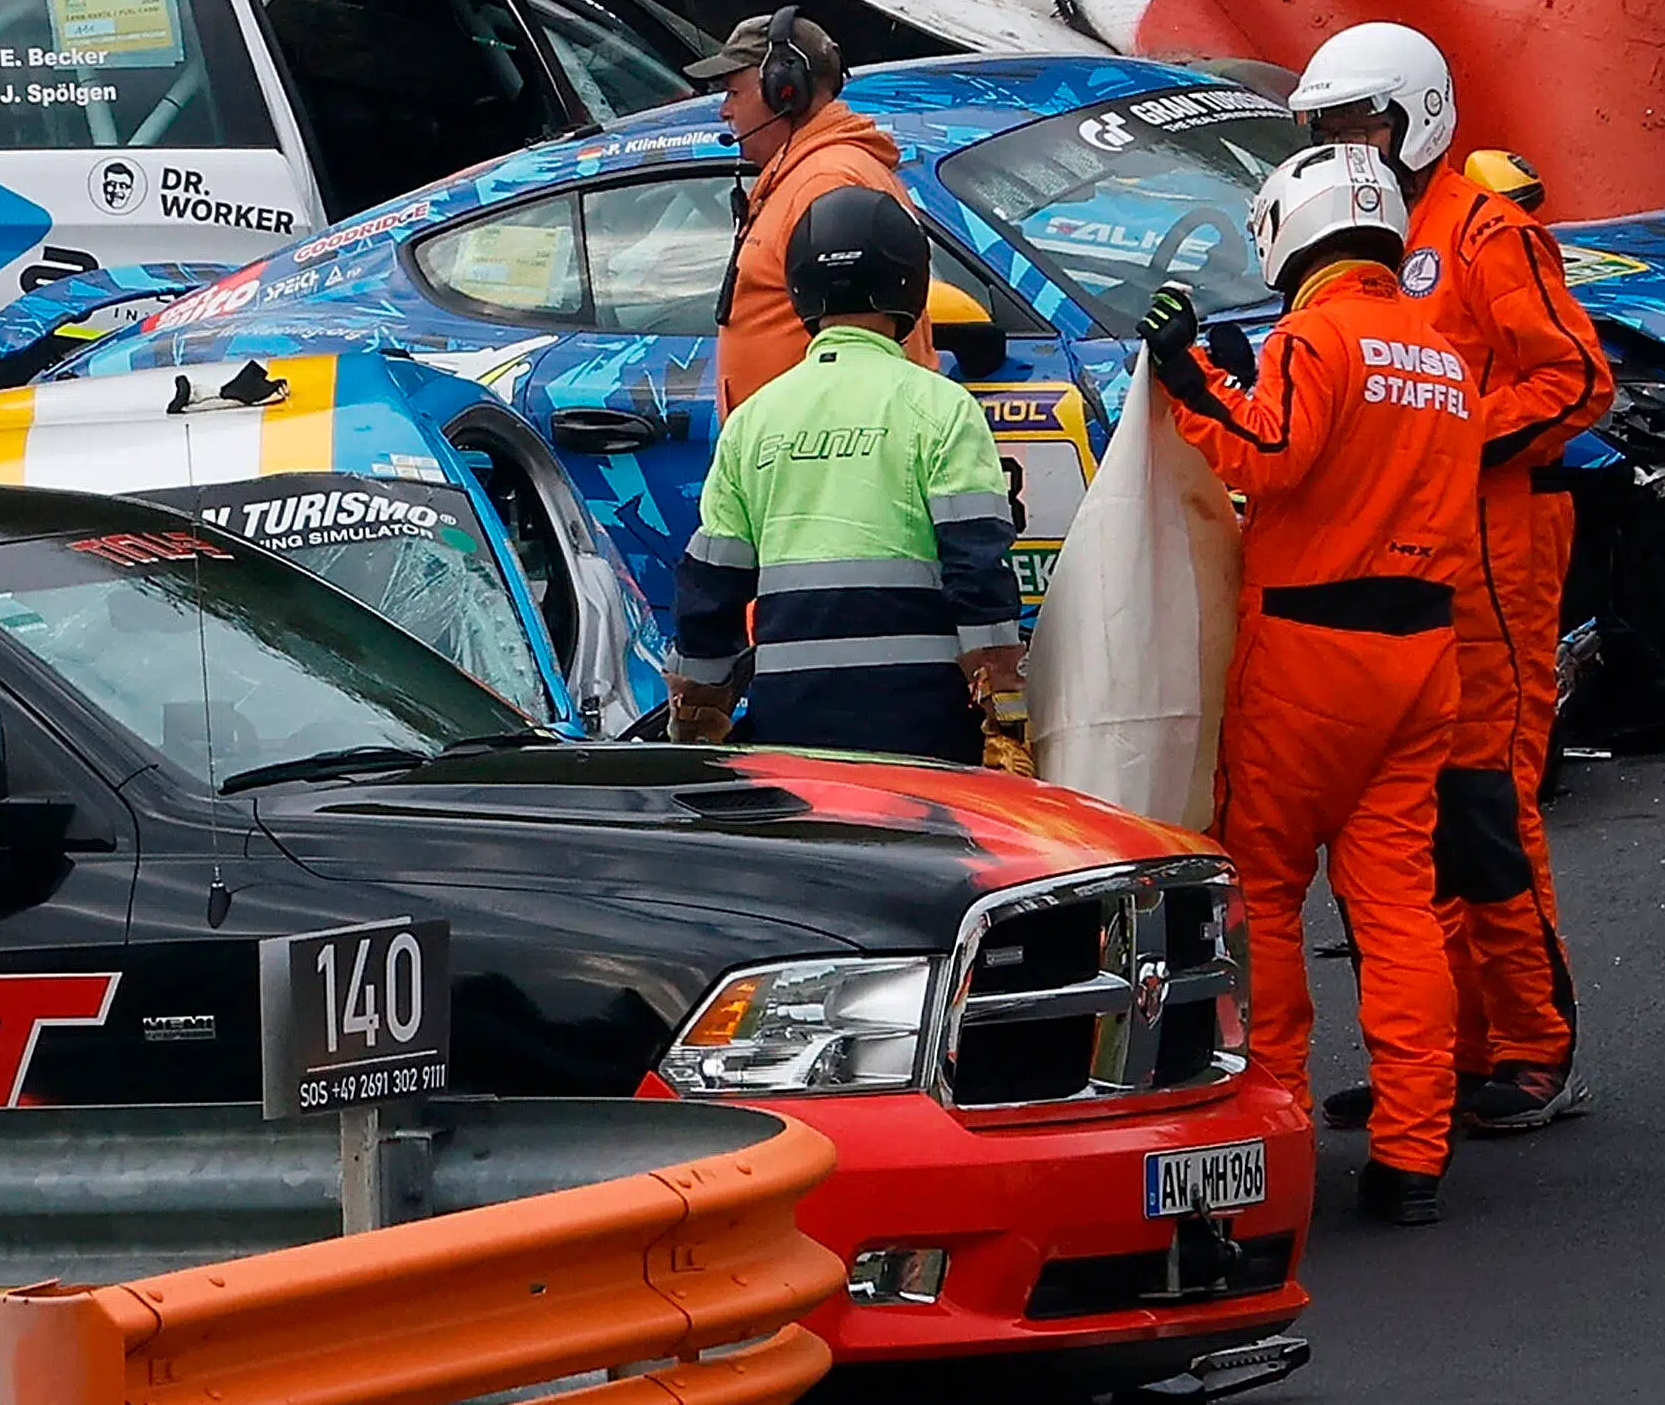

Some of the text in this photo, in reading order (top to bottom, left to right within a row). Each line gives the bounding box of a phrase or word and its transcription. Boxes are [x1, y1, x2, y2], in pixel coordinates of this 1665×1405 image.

[0, 48, 109, 67] E. Becker
[0, 82, 117, 107] J. Spölgen
[625, 131, 721, 153] Klinkmüller
[160, 167, 211, 196] DR.
[160, 197, 294, 235] WORKER
[293, 202, 430, 262] GOODRIDGE
[1359, 338, 1463, 381] DMSB
[1364, 374, 1470, 420] STAFFEL
[756, 426, 888, 470] E-UNIT
[308, 521, 434, 548] SIMULATOR
[317, 932, 422, 1052] 140
[300, 1064, 446, 1107] SOS +49 2691 302 9111
[1230, 1148, 1264, 1199] 966
